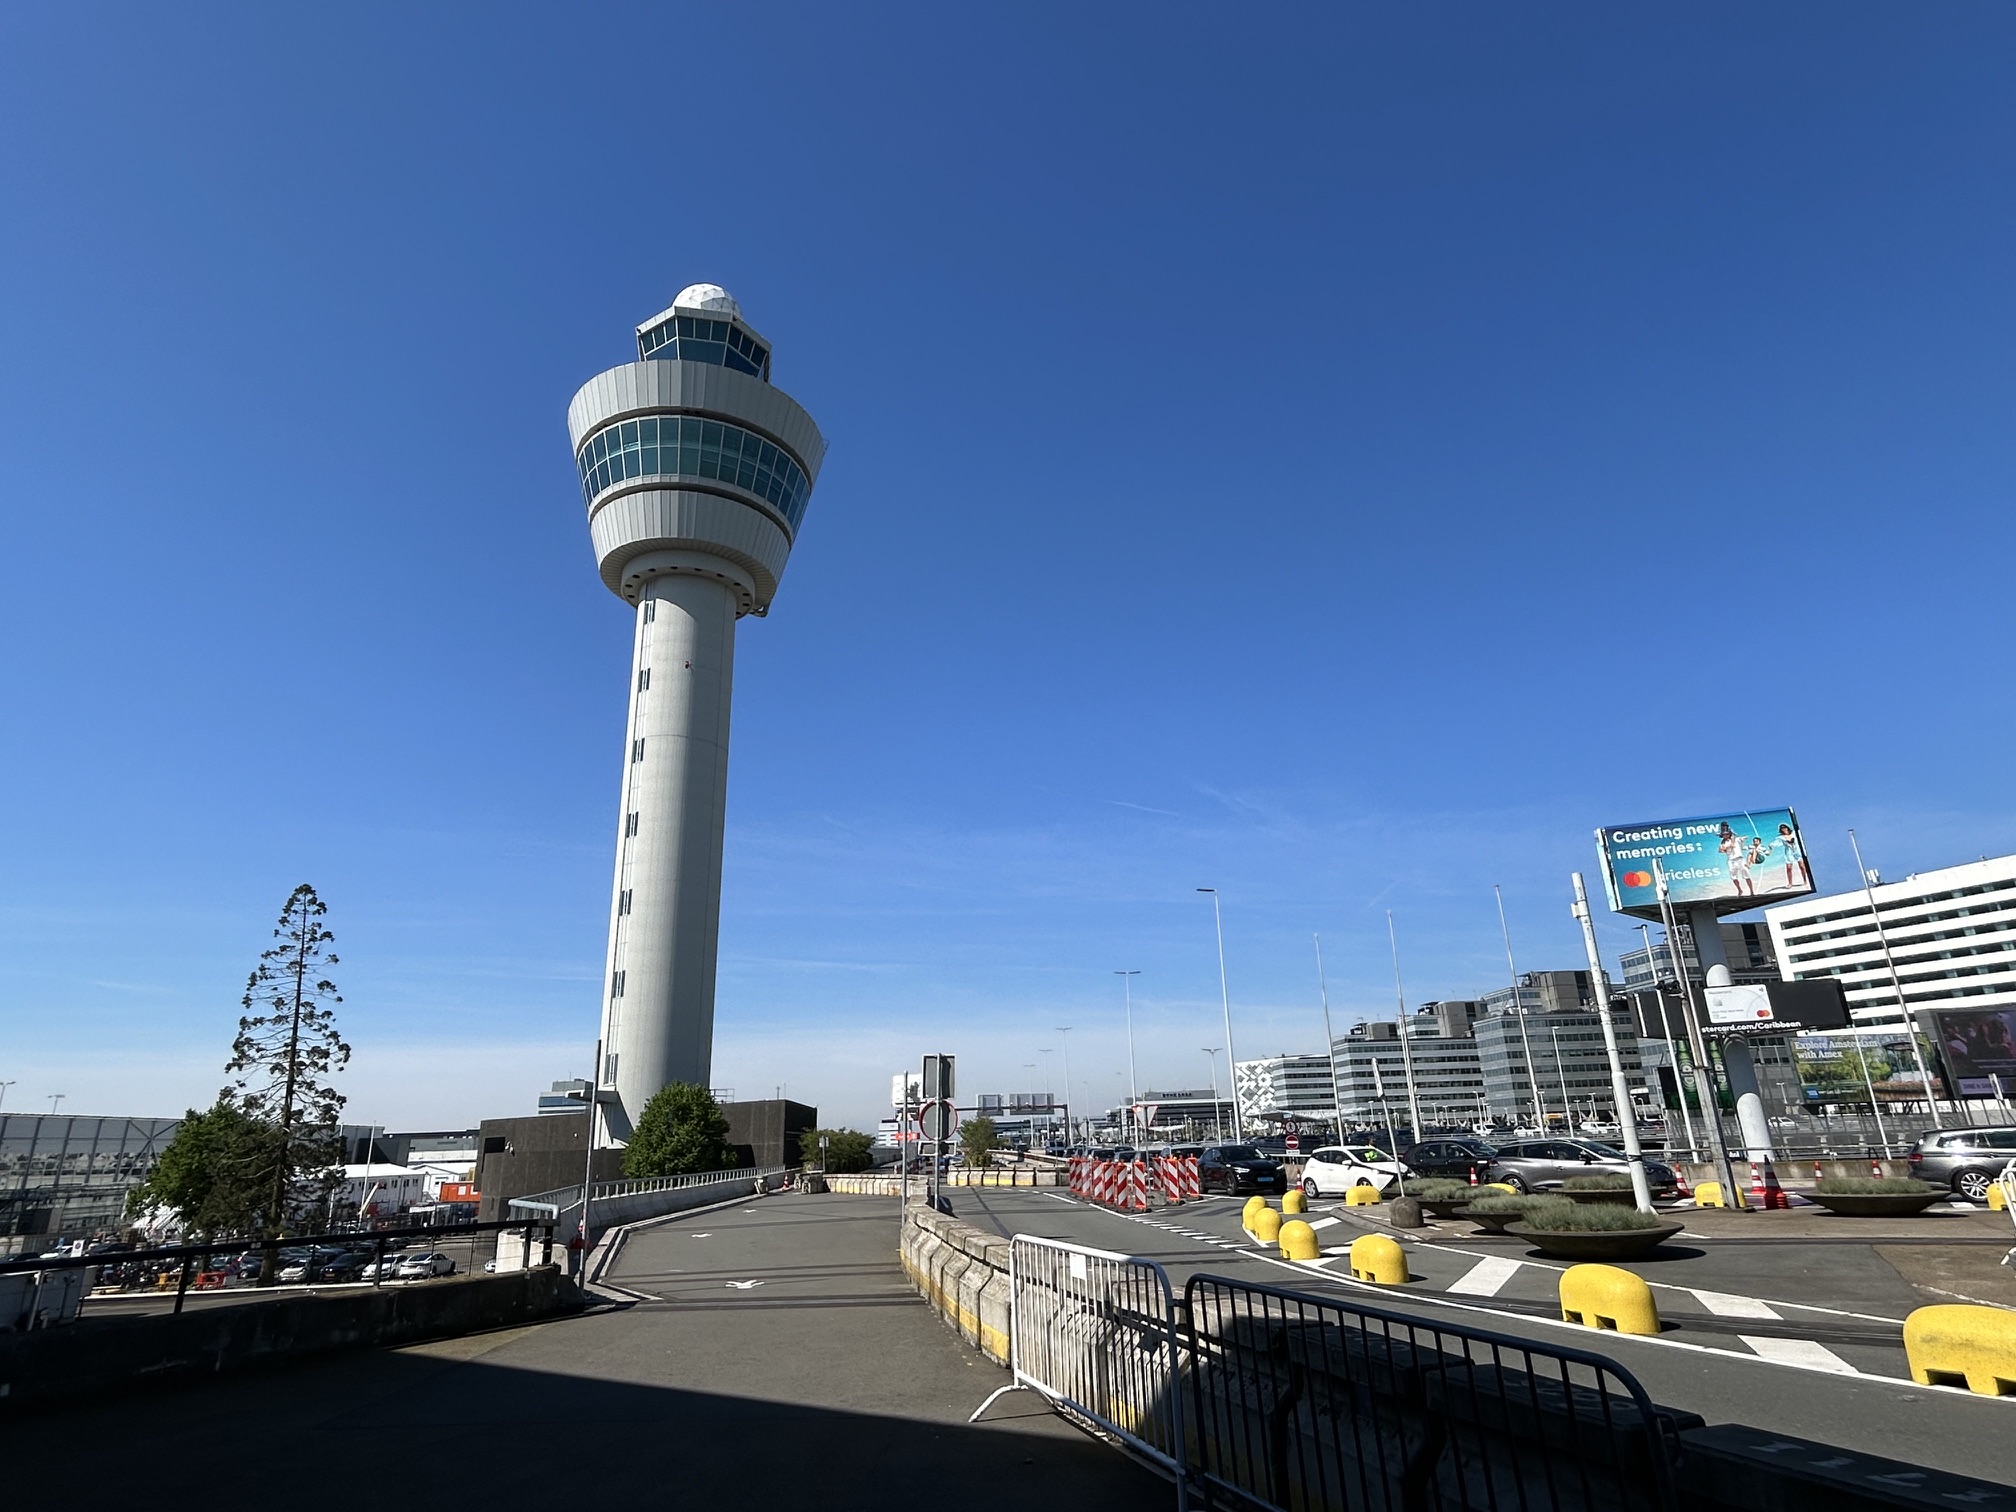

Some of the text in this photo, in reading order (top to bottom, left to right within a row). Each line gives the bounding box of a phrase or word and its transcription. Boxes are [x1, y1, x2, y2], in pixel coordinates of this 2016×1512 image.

[1612, 823, 1720, 843] Creating new
[1616, 841, 1702, 859] memories:
[1664, 867, 1721, 881] riceless
[1701, 1021, 1802, 1033] stercard.com/Caribbean
[1794, 1041, 1827, 1051] Explore
[1797, 1050, 1843, 1059] with Amex
